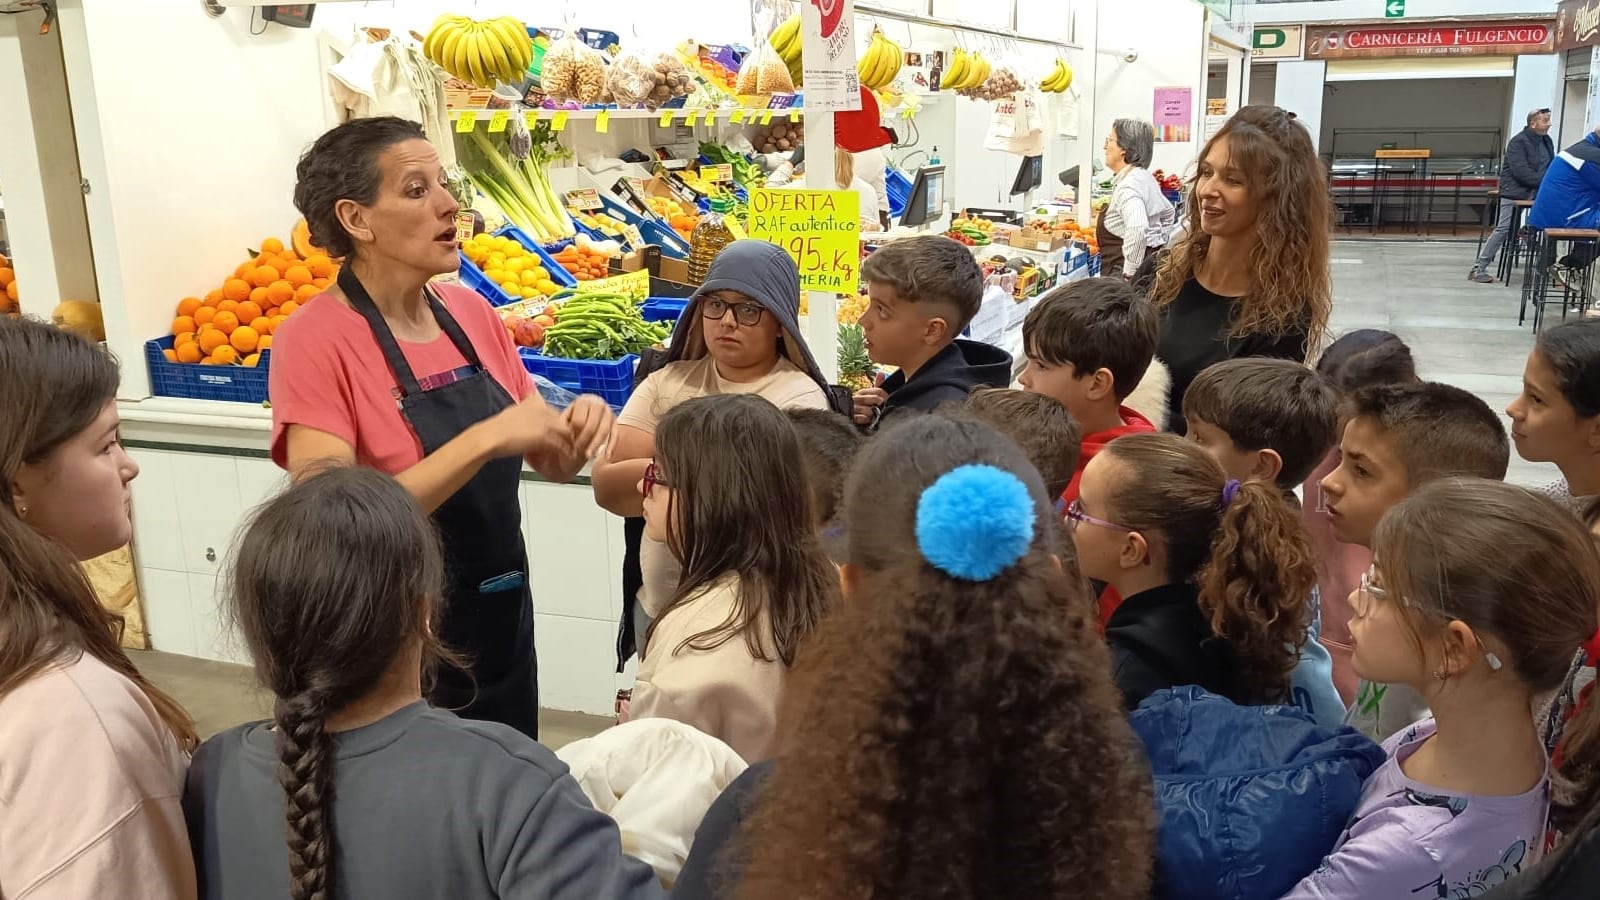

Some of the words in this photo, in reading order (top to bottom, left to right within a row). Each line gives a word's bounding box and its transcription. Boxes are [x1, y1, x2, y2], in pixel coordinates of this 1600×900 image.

[1348, 28, 1443, 48] CARNICERÍA
[1452, 28, 1544, 45] FULGENCIO
[753, 191, 836, 213] OFERTA
[754, 215, 787, 233] RAF
[832, 249, 854, 282] Kg
